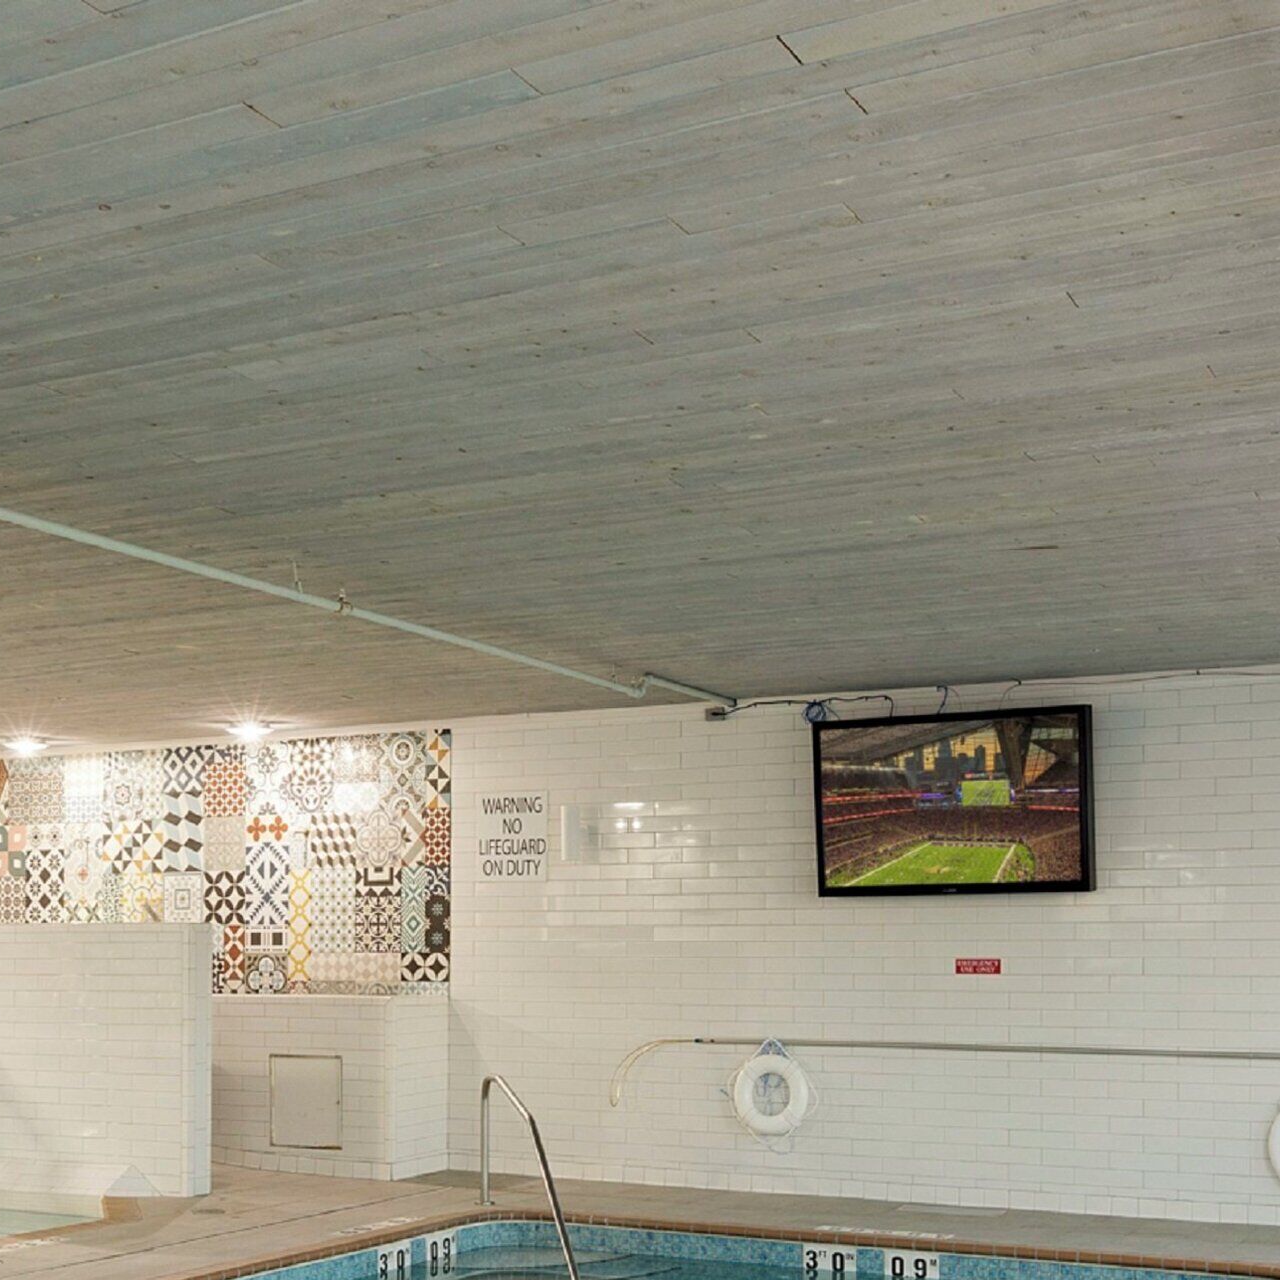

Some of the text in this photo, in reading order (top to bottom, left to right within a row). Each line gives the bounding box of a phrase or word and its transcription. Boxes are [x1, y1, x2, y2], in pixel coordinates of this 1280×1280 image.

[482, 797, 543, 814] WARNING
[502, 818, 522, 834] NO
[479, 839, 546, 855] LIFEGUARD
[483, 860, 541, 876] ON DUTY
[806, 1250, 818, 1270] 3
[832, 1252, 844, 1272] 0
